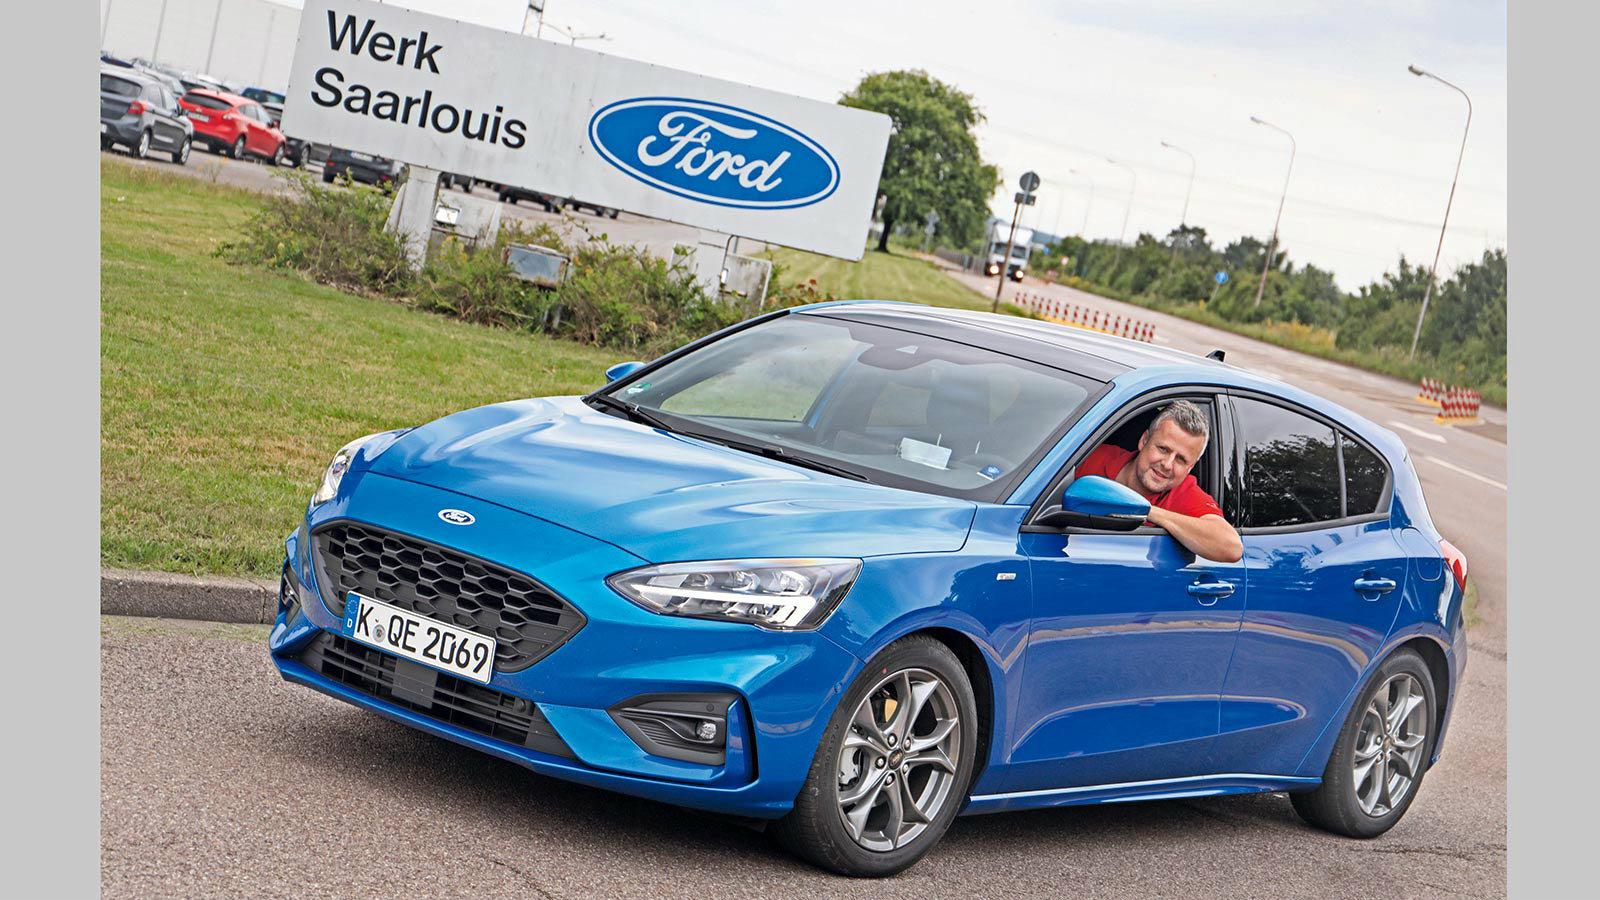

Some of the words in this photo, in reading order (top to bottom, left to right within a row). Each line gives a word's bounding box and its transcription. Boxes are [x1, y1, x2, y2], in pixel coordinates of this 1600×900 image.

[327, 9, 443, 74] Werk
[311, 67, 527, 149] Saarlouis
[637, 111, 791, 192] Ford
[346, 618, 353, 628] D
[356, 603, 374, 637] K
[387, 614, 420, 653] QE
[422, 626, 489, 674] 2069
